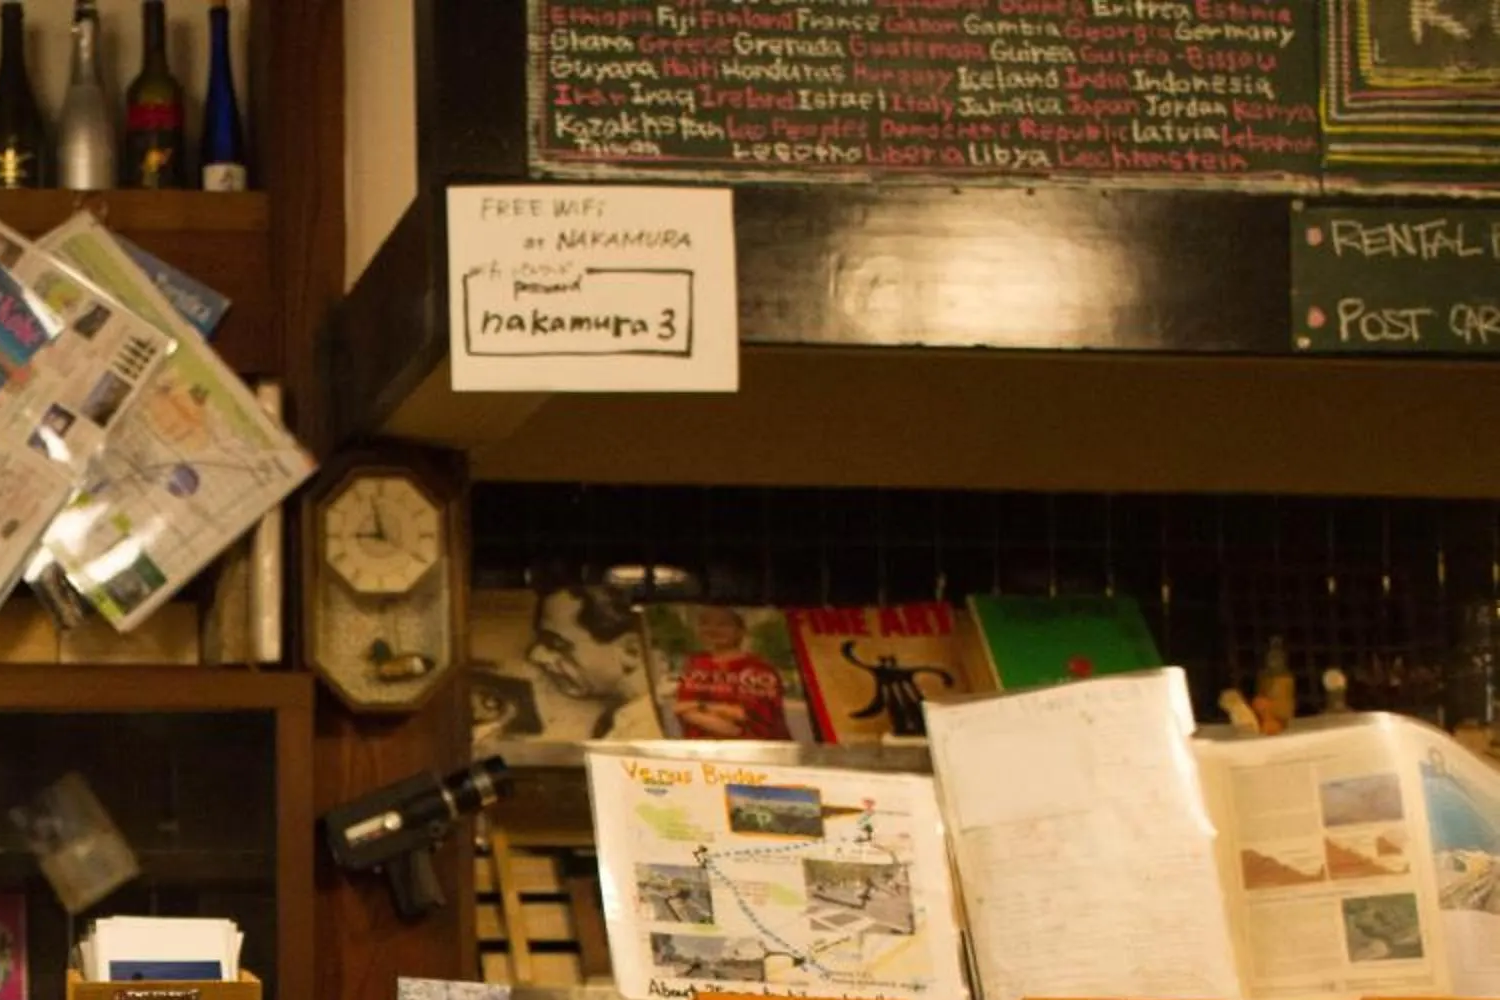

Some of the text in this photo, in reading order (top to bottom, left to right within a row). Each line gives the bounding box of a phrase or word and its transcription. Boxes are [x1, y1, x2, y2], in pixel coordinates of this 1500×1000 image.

[656, 5, 696, 36] Fiji
[701, 7, 794, 30] Finland
[797, 8, 880, 32] France
[964, 13, 1061, 36] Gambia
[1174, 20, 1296, 48] Germany
[551, 28, 635, 52] Ghana
[733, 31, 846, 58] Grenada
[989, 39, 1077, 64] Guinea
[550, 54, 660, 83] Guyana
[662, 56, 719, 79] Haiti
[721, 57, 847, 83] Honduras
[957, 63, 1060, 94] Iceland
[1063, 65, 1130, 94] India
[1132, 69, 1276, 100] Indonesia
[553, 83, 627, 106] Iran
[628, 81, 696, 114] Iraq
[697, 84, 795, 110] Ireland
[798, 87, 886, 113] Israel
[1143, 94, 1228, 118] Jordan
[1132, 119, 1221, 143] Latvia
[968, 141, 1052, 169] Libya
[481, 198, 542, 219] FREE
[523, 229, 692, 251] at NAKAMURA
[1332, 219, 1484, 261] RENTAL
[1337, 298, 1436, 342] POST
